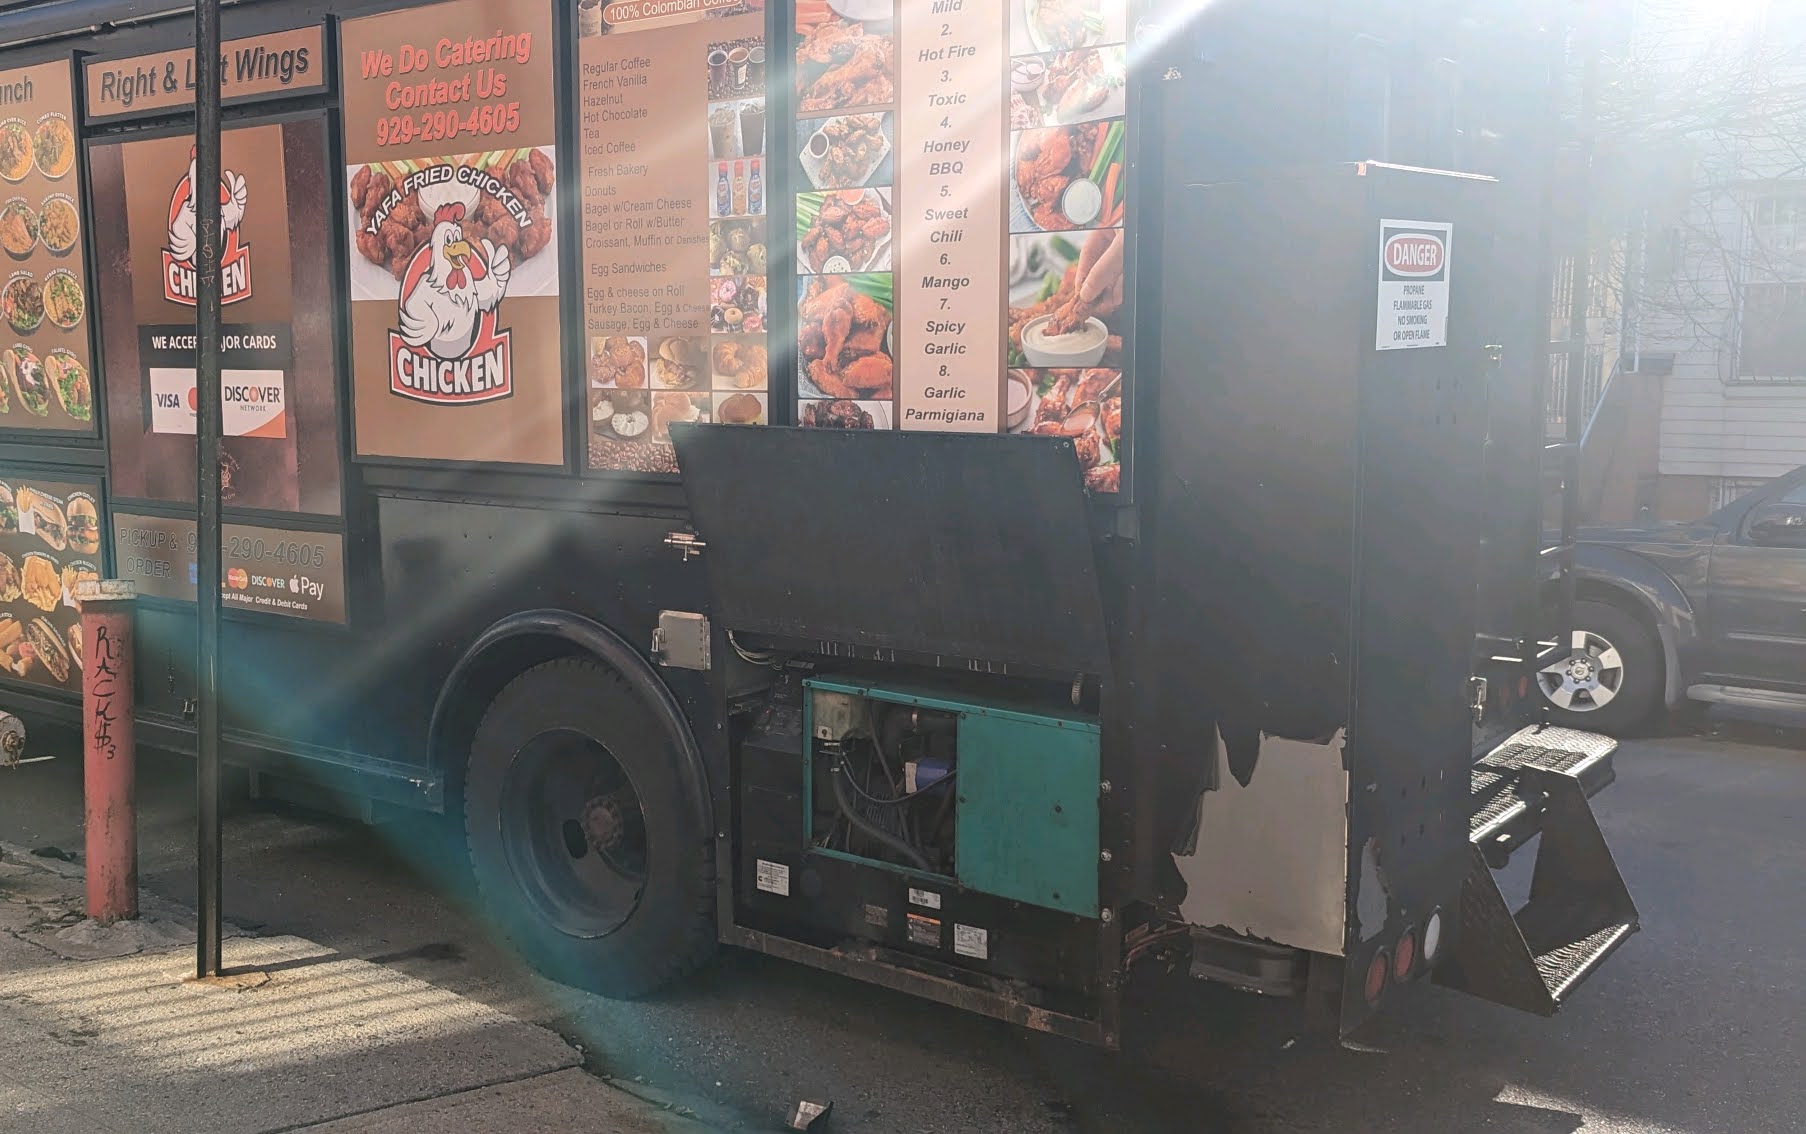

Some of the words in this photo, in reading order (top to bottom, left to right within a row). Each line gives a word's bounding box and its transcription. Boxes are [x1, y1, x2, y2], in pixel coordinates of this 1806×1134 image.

[610, 5, 639, 20] 100%
[642, 0, 699, 16] Colombian
[932, 0, 962, 14] Mild
[941, 24, 952, 36] 2.
[360, 49, 393, 78] We
[399, 45, 429, 74] Do
[435, 30, 532, 68] Catering
[918, 49, 944, 62] Hot
[947, 45, 976, 59] Fire
[583, 61, 618, 76] Regular
[621, 57, 651, 70] Coffee
[101, 66, 157, 106] Right
[163, 61, 177, 93] &
[185, 54, 228, 90] Lt
[235, 46, 309, 84] Wings
[583, 78, 614, 91] French
[617, 74, 647, 87] Vanilla
[940, 70, 952, 82] 3.
[0, 75, 33, 104] nch
[385, 73, 471, 110] Contact
[477, 68, 507, 99] Us
[583, 93, 623, 107] Hazelnut
[928, 93, 966, 106] Toxic
[584, 111, 600, 123] Hot
[602, 107, 647, 121] Chocolate
[940, 116, 952, 128] 4.
[377, 101, 520, 146] 929-290-4605
[584, 127, 600, 139] Tea
[585, 144, 603, 155] Iced
[606, 142, 636, 154] Coffee
[923, 139, 970, 153] Honey
[588, 165, 614, 178] Fresh
[617, 163, 648, 178] Bakery
[929, 161, 963, 175] BBQ
[585, 185, 616, 197] Donuts
[940, 185, 951, 197] 5.
[367, 192, 402, 235] YAFA
[403, 167, 452, 195] FRIED
[457, 167, 532, 228] CHICKEN
[585, 203, 610, 216] Bagel
[613, 200, 653, 213] w/Cream
[656, 199, 692, 210] Cheese
[925, 207, 968, 220] Sweet
[585, 220, 611, 233] Bagel
[614, 221, 622, 229] or
[625, 218, 643, 229] Roll
[647, 216, 684, 229] w/Butter
[586, 237, 631, 249] Croissant,
[634, 235, 662, 247] Muffin
[665, 236, 674, 245] or
[930, 230, 962, 243] Chili
[940, 254, 951, 265] 6.
[1393, 243, 1437, 266] DANGER
[592, 263, 609, 276] Egg
[611, 261, 667, 274] Sandwiches
[168, 256, 246, 300] CHIEN
[921, 276, 970, 290] Mango
[587, 287, 604, 300] Egg
[608, 286, 614, 297] &
[617, 287, 649, 298] cheese
[652, 288, 663, 297] on
[666, 285, 685, 296] Roll
[1403, 285, 1424, 295] PROPANE
[588, 303, 618, 316] Turkey
[654, 302, 673, 315] Egg
[675, 305, 680, 313] &
[683, 303, 710, 313] Cheese
[940, 298, 951, 310] 7.
[1393, 300, 1422, 310] FLAMMABLE
[1423, 300, 1432, 310] GAS
[588, 320, 630, 332] Sausage,
[633, 319, 651, 331] Egg
[654, 318, 660, 329] &
[663, 317, 698, 329] Cheese
[1398, 315, 1405, 325] NO
[1406, 315, 1427, 325] SMOKING
[925, 321, 966, 335] Spicy
[1393, 331, 1401, 341] OR
[1402, 330, 1415, 340] OPEN
[1415, 329, 1430, 339] FLAME
[152, 336, 167, 349] WE
[243, 335, 276, 349] CARDS
[925, 343, 966, 355] Garlic
[397, 344, 504, 394] CHICKEN
[939, 365, 950, 377] 8.
[155, 393, 180, 409] VISA
[225, 386, 281, 403] DISCOVER
[924, 387, 966, 399] Garlic
[905, 408, 985, 423] Parmigiana
[120, 528, 166, 550] PICKUP
[168, 533, 177, 550] &
[187, 532, 325, 568] 9-290-4605
[127, 557, 171, 578] ORDER
[252, 575, 285, 590] DISCOVER
[301, 575, 324, 600] Pay
[239, 593, 254, 604] Major
[255, 596, 271, 605] Credit
[272, 598, 276, 606] &
[277, 599, 291, 608] Debit
[292, 601, 308, 610] Cards
